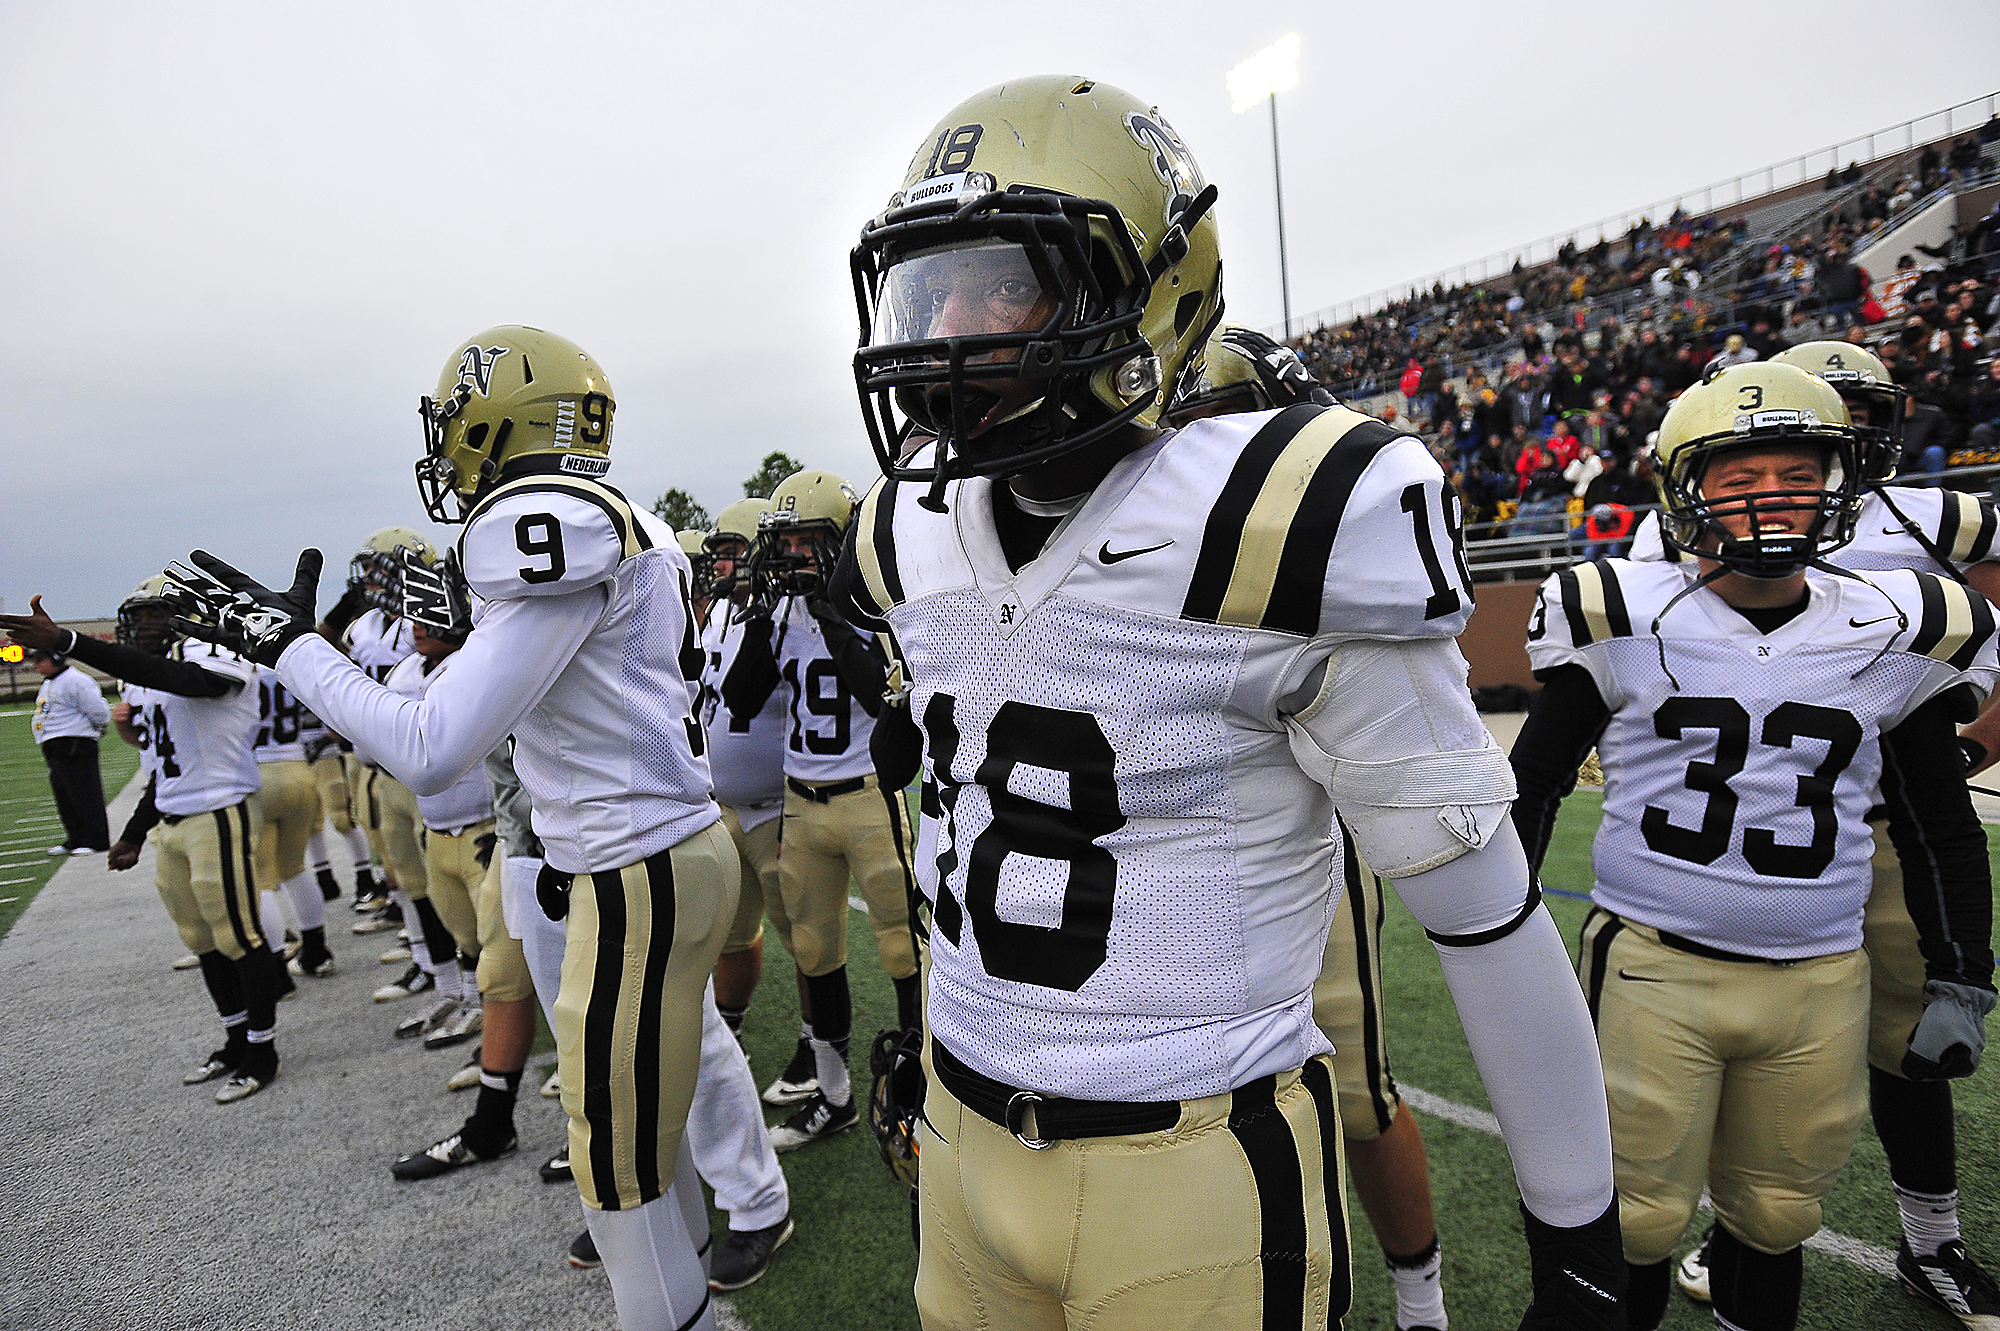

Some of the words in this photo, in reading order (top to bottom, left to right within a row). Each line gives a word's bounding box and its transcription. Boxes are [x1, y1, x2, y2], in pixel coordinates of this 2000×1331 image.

[923, 124, 984, 178] 18
[910, 182, 954, 203] BULLDOGS
[1827, 354, 1844, 369] 4
[581, 390, 608, 443] 9
[1739, 386, 1763, 410] 3
[1762, 415, 1798, 424] BULLDOGS
[514, 512, 566, 584] 9
[782, 658, 851, 755] 19
[1641, 696, 1864, 873] 33
[922, 691, 1128, 992] 18
